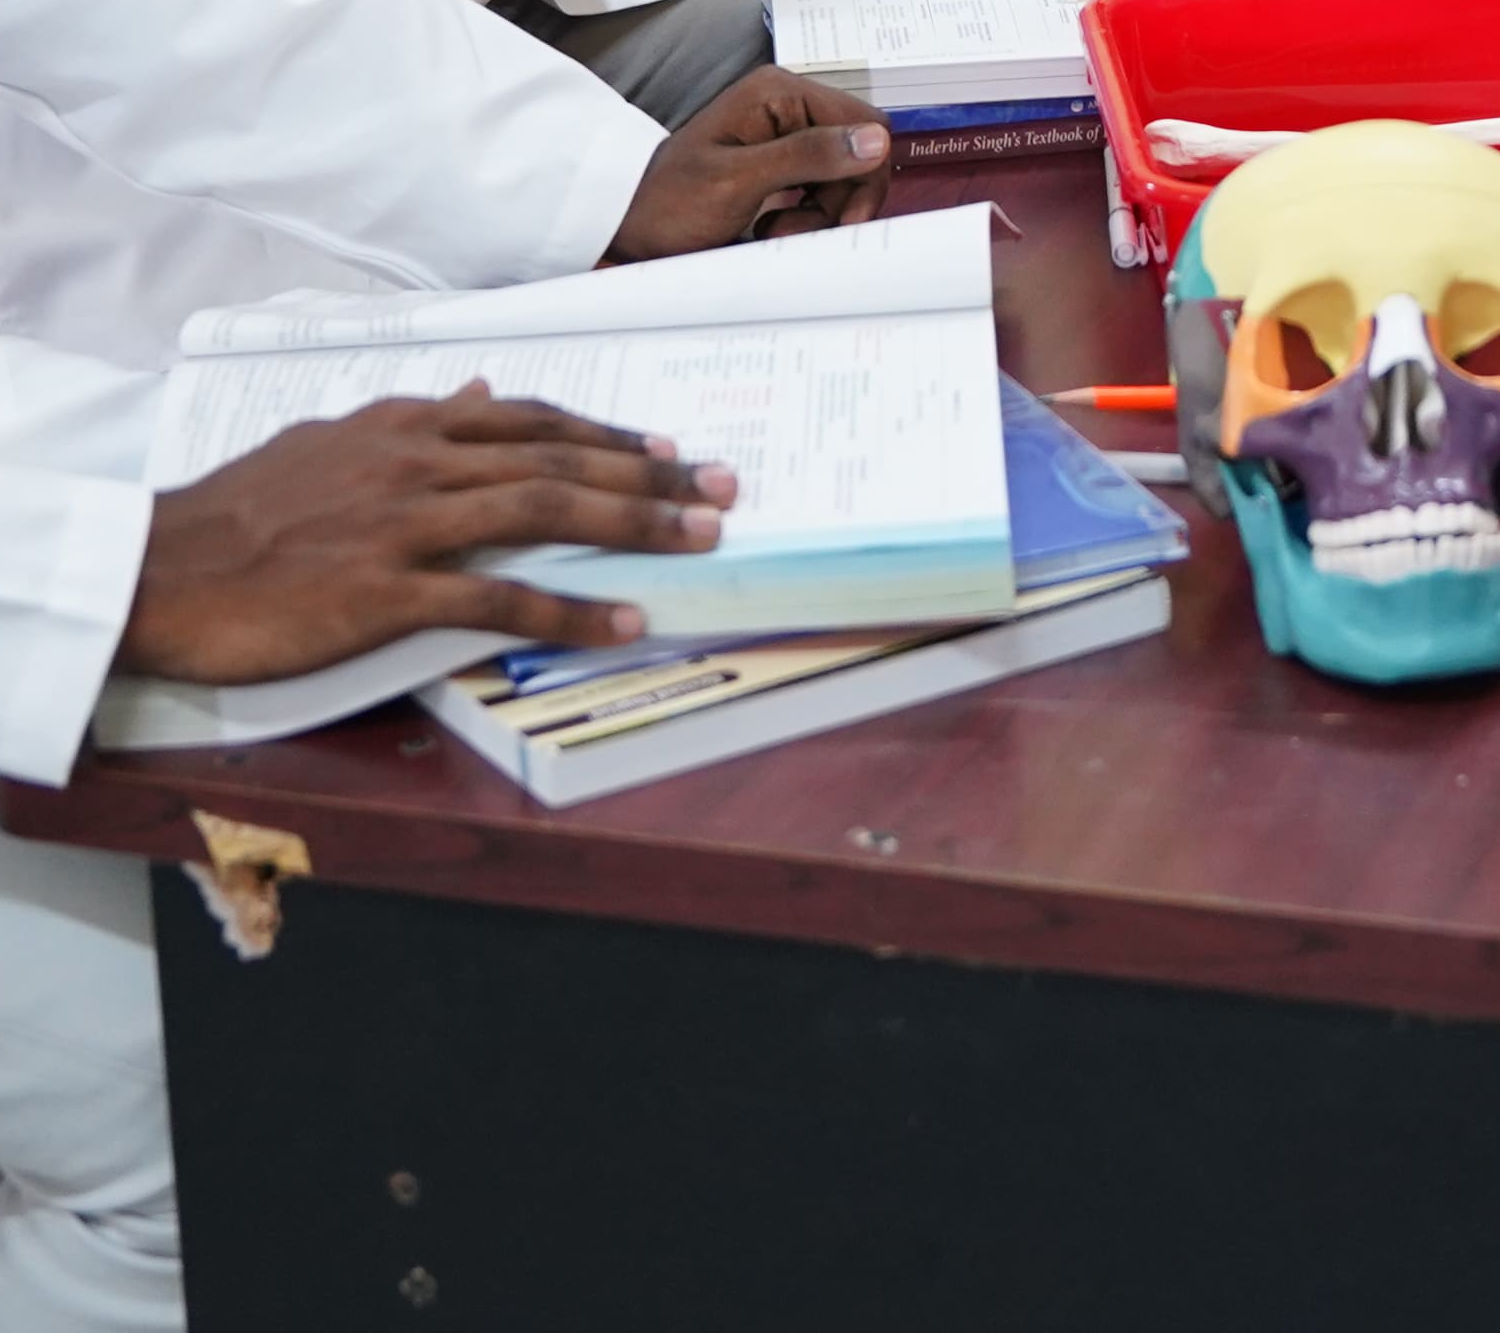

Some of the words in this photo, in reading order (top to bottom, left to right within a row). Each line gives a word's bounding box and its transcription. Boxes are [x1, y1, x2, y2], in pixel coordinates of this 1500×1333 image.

[910, 139, 970, 158] Inderbir
[972, 131, 1021, 154] Singh's
[1025, 126, 1083, 147] Textbook
[1086, 124, 1102, 143] of
